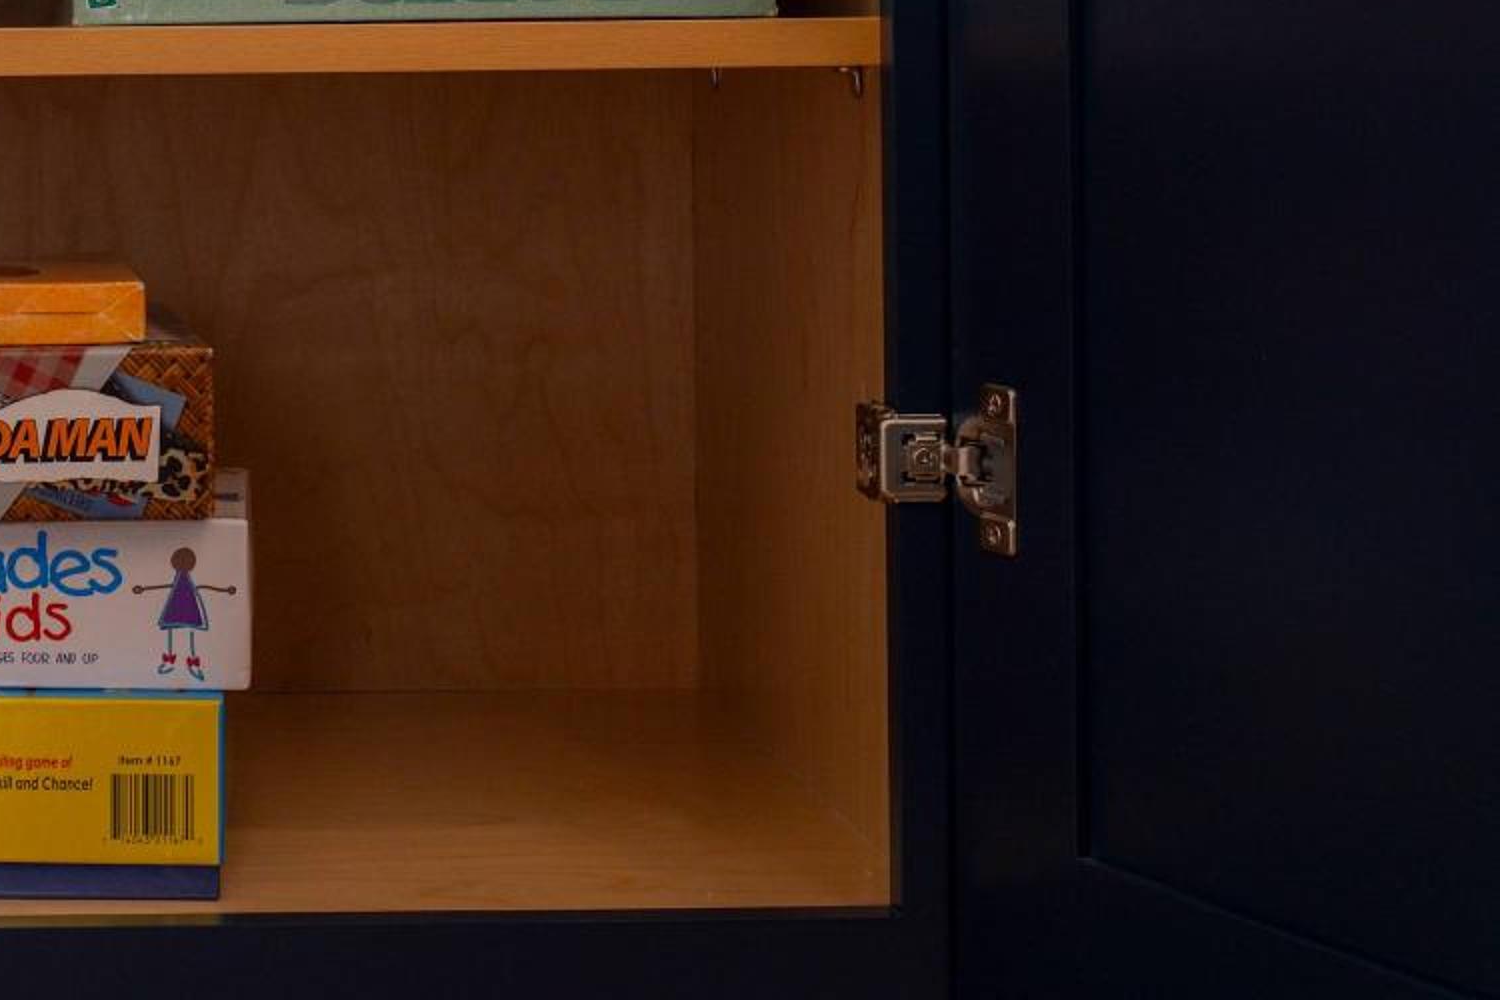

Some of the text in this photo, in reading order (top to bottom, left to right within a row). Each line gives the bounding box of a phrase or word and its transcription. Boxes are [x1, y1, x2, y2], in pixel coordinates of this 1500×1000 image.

[46, 416, 154, 463] MAN
[21, 651, 51, 665] FOUR
[55, 652, 78, 665] AND
[82, 652, 100, 665] UP
[25, 757, 58, 771] game
[60, 756, 72, 769] of
[118, 755, 143, 765] Item
[15, 776, 40, 790] and
[41, 775, 94, 791] Chance!
